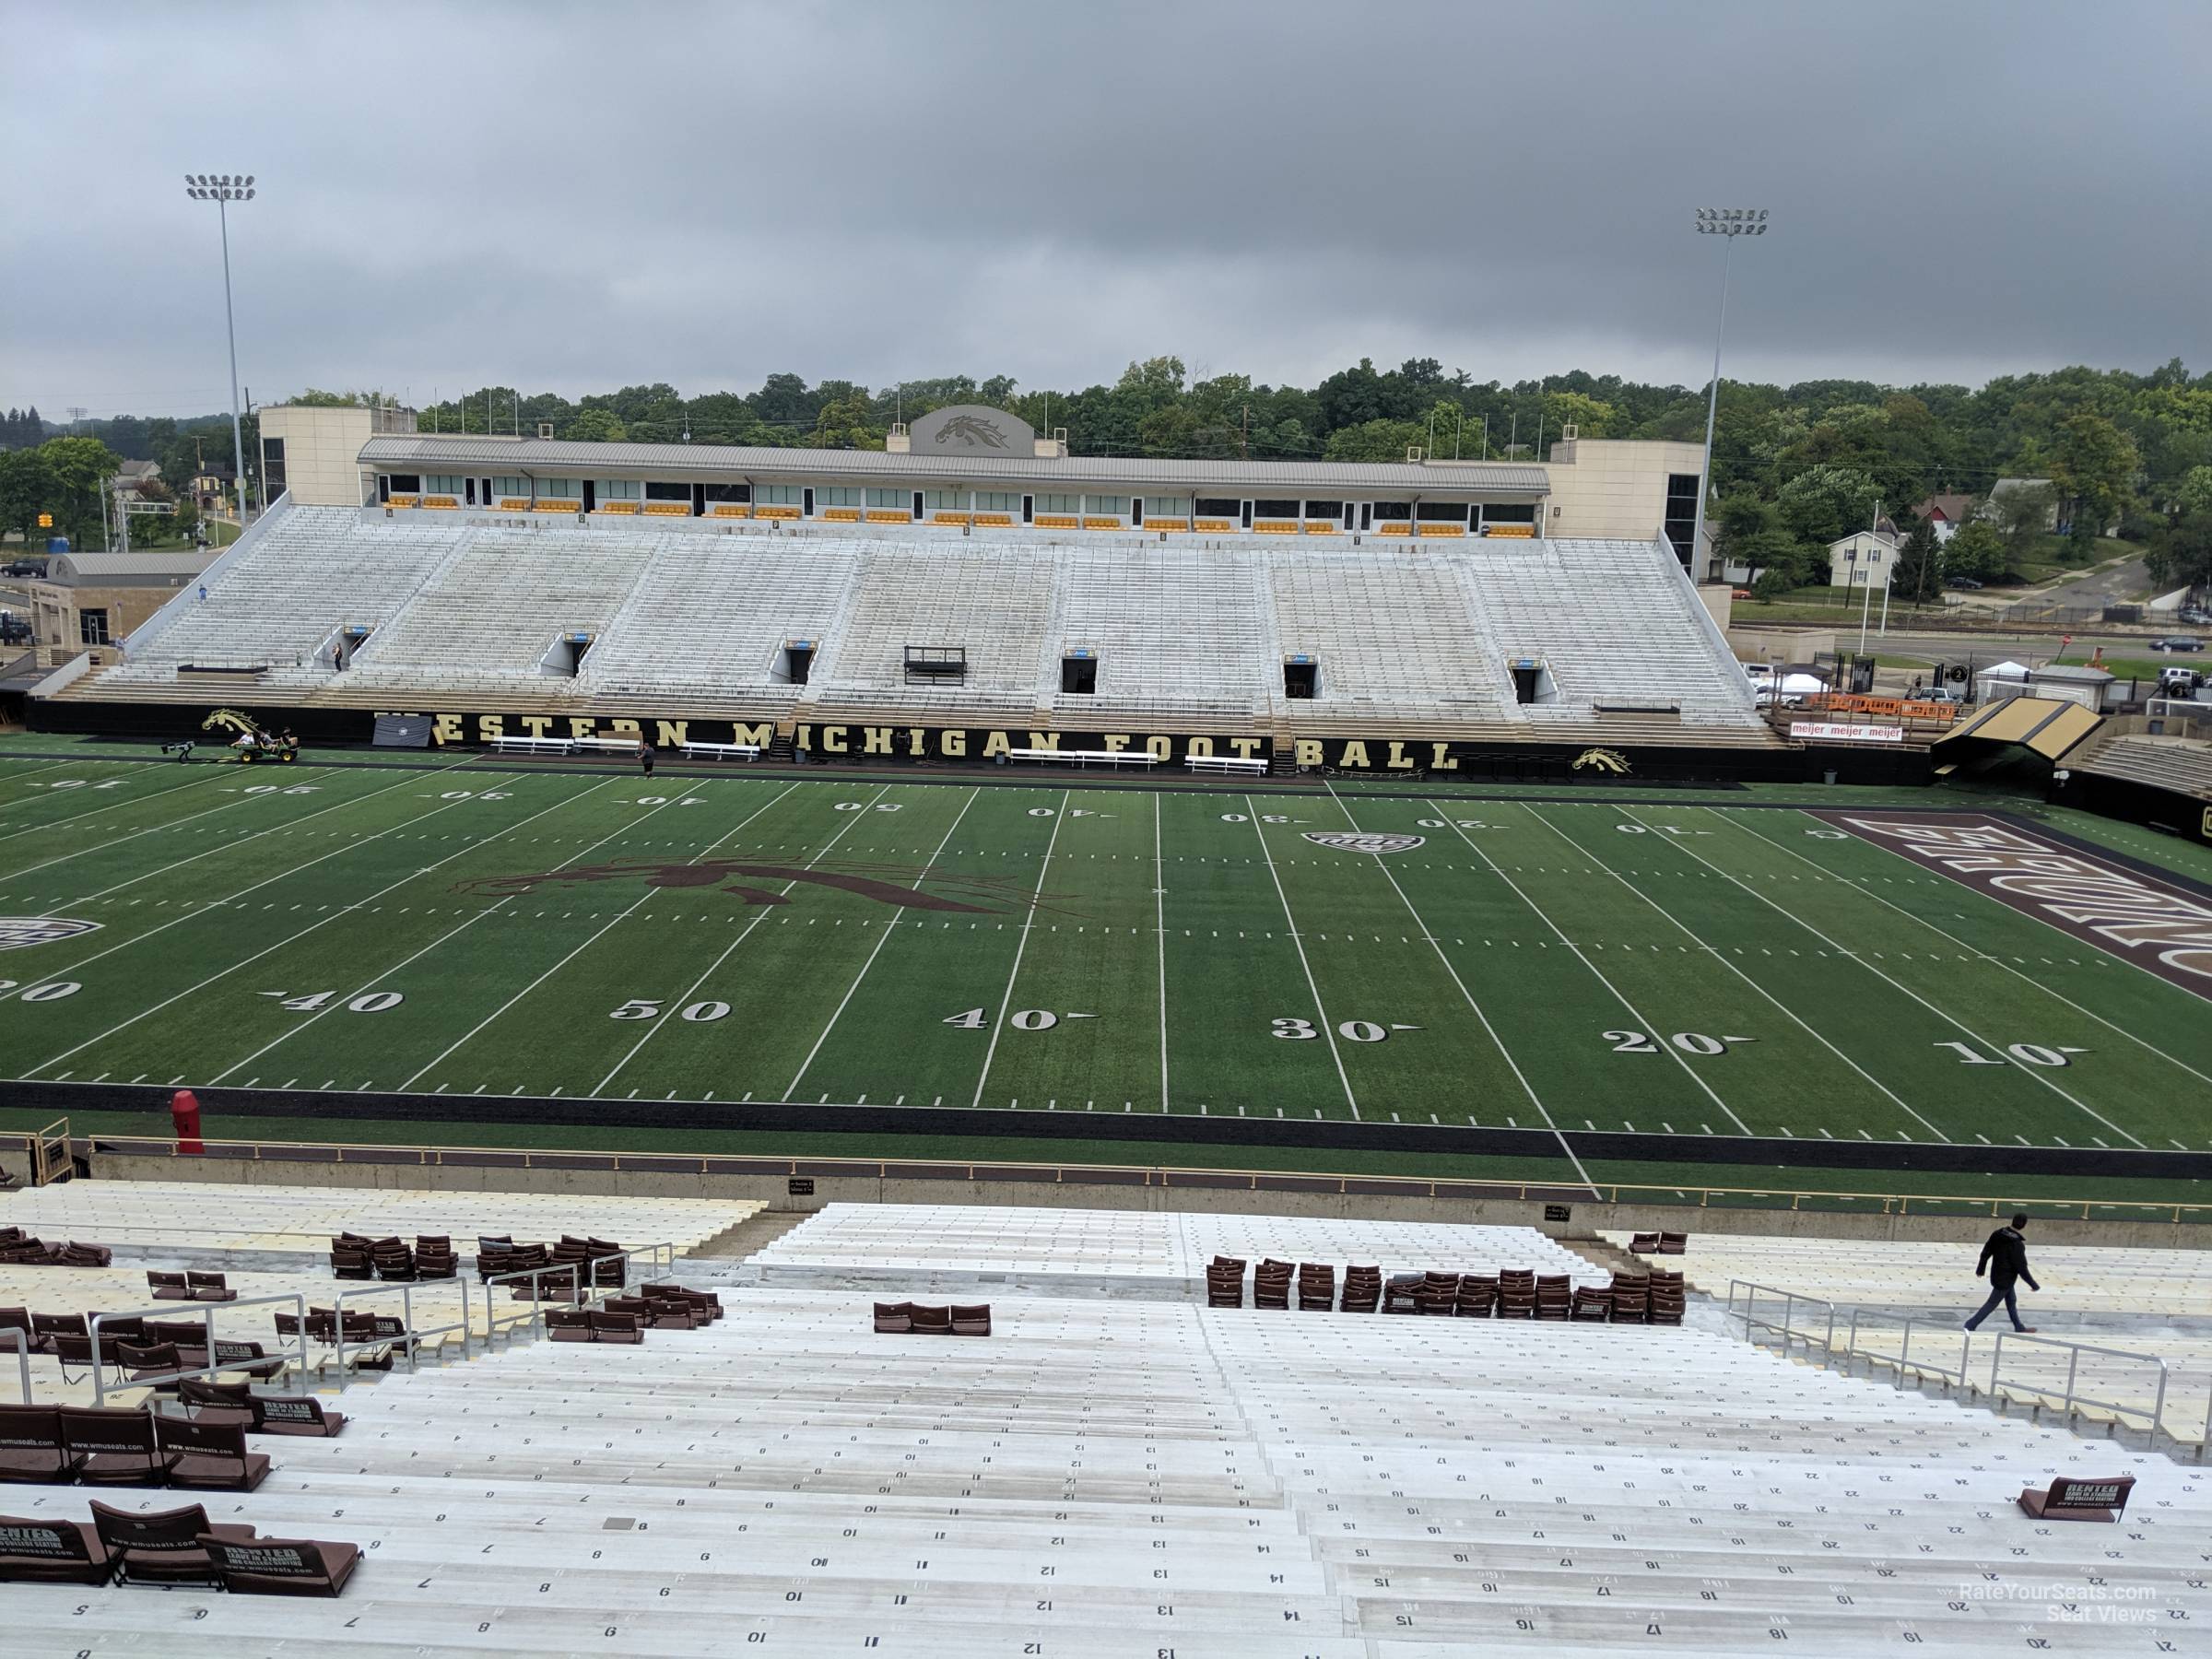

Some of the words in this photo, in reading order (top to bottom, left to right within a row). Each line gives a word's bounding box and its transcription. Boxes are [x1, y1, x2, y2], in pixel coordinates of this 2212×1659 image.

[374, 712, 688, 747] ESTEN
[733, 723, 1061, 758] MICHIGAN
[1792, 724, 1824, 735] meijer
[1830, 725, 1863, 737] meijer
[1869, 726, 1901, 738] meijer
[263, 1401, 310, 1411] RENTED
[0, 1438, 55, 1446] wmuseats.com
[71, 1441, 144, 1451] www.wmuseats.com
[167, 1443, 234, 1454] www.wmuseats.com
[619, 1476, 631, 1485] 7
[2065, 1484, 2120, 1493] RENTED
[1063, 1492, 1075, 1501] 12
[32, 1498, 47, 1507] 2
[1238, 1499, 1250, 1508] 14
[1733, 1502, 1749, 1512] 20
[331, 1509, 345, 1518] 5
[435, 1513, 446, 1523] 6
[1054, 1512, 1067, 1521] 12
[1976, 1512, 1994, 1521] 23
[636, 1522, 649, 1532] 8
[0, 1527, 60, 1539] ENTED
[842, 1528, 857, 1537] 10
[935, 1531, 947, 1540] 11
[1533, 1530, 1545, 1539] 17
[111, 1536, 197, 1548] www.wmuseats.com
[369, 1540, 382, 1549] 6
[1051, 1536, 1065, 1546] 12
[1152, 1540, 1166, 1549] 13
[1821, 1540, 1841, 1549] 20
[224, 1547, 300, 1558] RENTED
[481, 1544, 495, 1554] 7
[592, 1549, 603, 1559] 8
[1257, 1545, 1270, 1554] 14
[700, 1552, 711, 1561] 9
[1453, 1553, 1469, 1562] 16
[2104, 1550, 2124, 1559] 23
[916, 1560, 929, 1570] 11
[1559, 1558, 1573, 1567] 17
[1645, 1560, 1661, 1570] 18
[1041, 1566, 1055, 1576] 12
[1153, 1570, 1168, 1579] 13
[1777, 1565, 1794, 1574] 19
[1875, 1567, 1898, 1578] 20
[1269, 1573, 1284, 1584] 14
[1981, 1571, 2000, 1582] 21
[2086, 1576, 2108, 1586] 22
[417, 1577, 432, 1589] 7
[1373, 1578, 1390, 1587] 15
[2186, 1579, 2208, 1590] 23
[538, 1583, 551, 1593] 8
[659, 1587, 671, 1596] 9
[1481, 1583, 1498, 1593] 16
[1596, 1586, 1611, 1596] 17
[785, 1591, 803, 1602] 10
[894, 1594, 908, 1606] 11
[1700, 1591, 1719, 1601] 18
[1836, 1594, 1855, 1606] 19
[72, 1605, 89, 1616] 5
[1036, 1600, 1053, 1611] 12
[1947, 1601, 1970, 1612] 20
[194, 1608, 209, 1620] 6
[1157, 1605, 1173, 1617] 13
[1283, 1610, 1300, 1621] 14
[2166, 1609, 2191, 1620] 22
[343, 1617, 360, 1628] 7
[1395, 1615, 1413, 1627] 15
[1515, 1618, 1535, 1630] 16
[477, 1621, 491, 1633] 8
[604, 1626, 618, 1637] 9
[1646, 1623, 1663, 1636] 17
[747, 1631, 767, 1643] 10
[1769, 1629, 1788, 1640] 18
[1902, 1631, 1924, 1643] 19
[864, 1636, 879, 1648] 11
[2026, 1638, 2052, 1650] 20
[2155, 1641, 2177, 1653] 21
[1023, 1642, 1041, 1655] 12
[1157, 1648, 1175, 1659] 13
